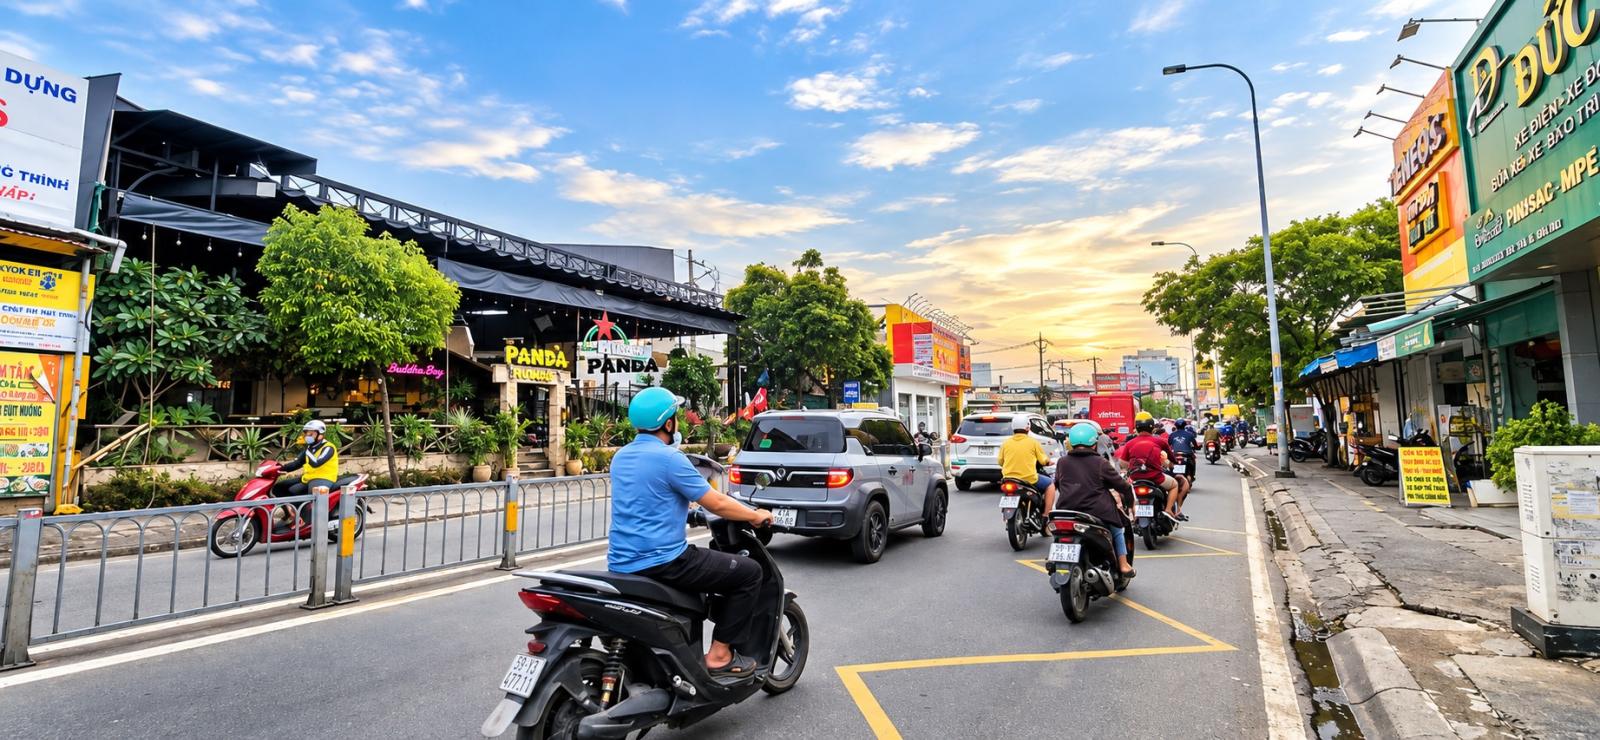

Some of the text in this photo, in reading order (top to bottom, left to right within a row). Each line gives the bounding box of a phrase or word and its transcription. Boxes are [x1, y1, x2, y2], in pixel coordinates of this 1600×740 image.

[5, 67, 77, 104] DỰNG
[0, 163, 14, 178] G
[426, 364, 445, 379] Boy
[588, 358, 659, 374] PANDA
[503, 671, 532, 694] 477.11
